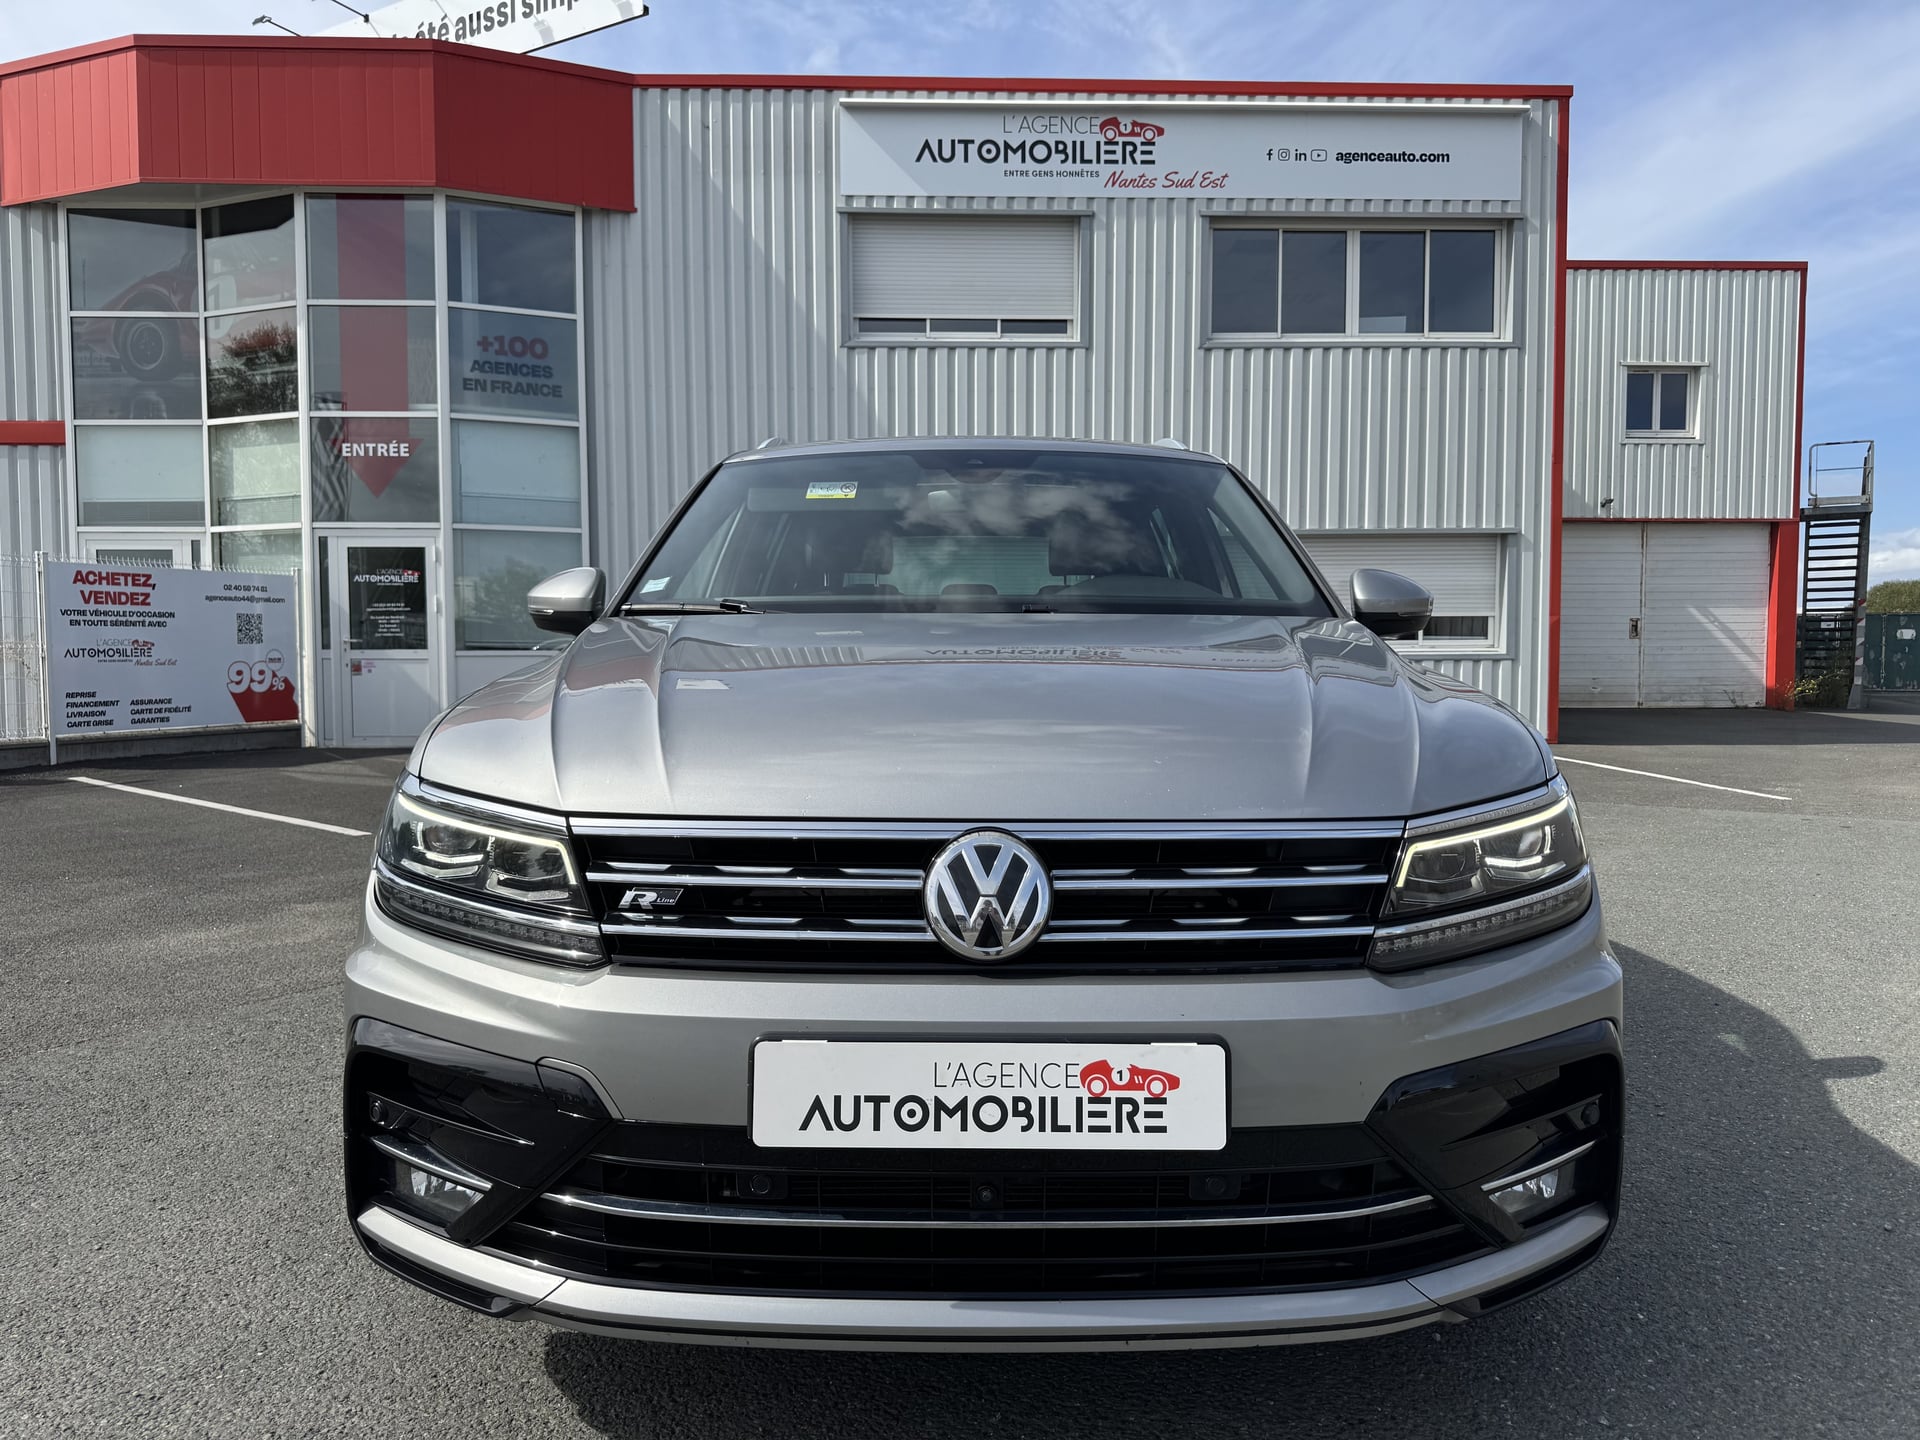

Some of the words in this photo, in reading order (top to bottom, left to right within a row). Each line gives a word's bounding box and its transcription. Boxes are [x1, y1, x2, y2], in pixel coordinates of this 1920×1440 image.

[455, 0, 515, 42] aussi
[1003, 116, 1100, 135] L'AGENCE
[1335, 151, 1450, 164] agenceauto.com
[1003, 169, 1030, 178] ENTRE
[1032, 170, 1054, 178] GENS
[1055, 168, 1100, 178] HONNÊTES
[1103, 170, 1157, 189] Nantes
[1161, 171, 1195, 189] Sud
[1200, 170, 1230, 189] Est
[477, 335, 549, 360] +100
[470, 360, 554, 379] AGENCES
[462, 378, 487, 393] EN
[491, 379, 563, 398] FRANCE
[341, 440, 410, 457] ENTRÉE
[72, 570, 157, 590] ACHETEZ,
[79, 590, 151, 606] VENDEZ
[60, 608, 87, 617] VOTRE
[88, 608, 128, 618] VÉHICULE
[128, 610, 176, 619] D'OCCASION
[69, 619, 81, 627] EN
[83, 619, 109, 628] TOUTE
[110, 618, 146, 628] SÉRÉNITÉ
[147, 620, 168, 628] AVEC
[65, 691, 97, 699] REPRISE
[65, 700, 120, 709] FINANCEMENT
[130, 698, 173, 706] ASSURANCE
[66, 710, 107, 718] LIVRAISON
[130, 707, 153, 715] CARTE
[164, 704, 192, 714] FIDÉLITÉ
[66, 720, 92, 728] CARTE
[92, 719, 115, 727] GRISE
[130, 716, 171, 725] GARANTIES
[933, 1062, 1080, 1089] L'AGENCE
